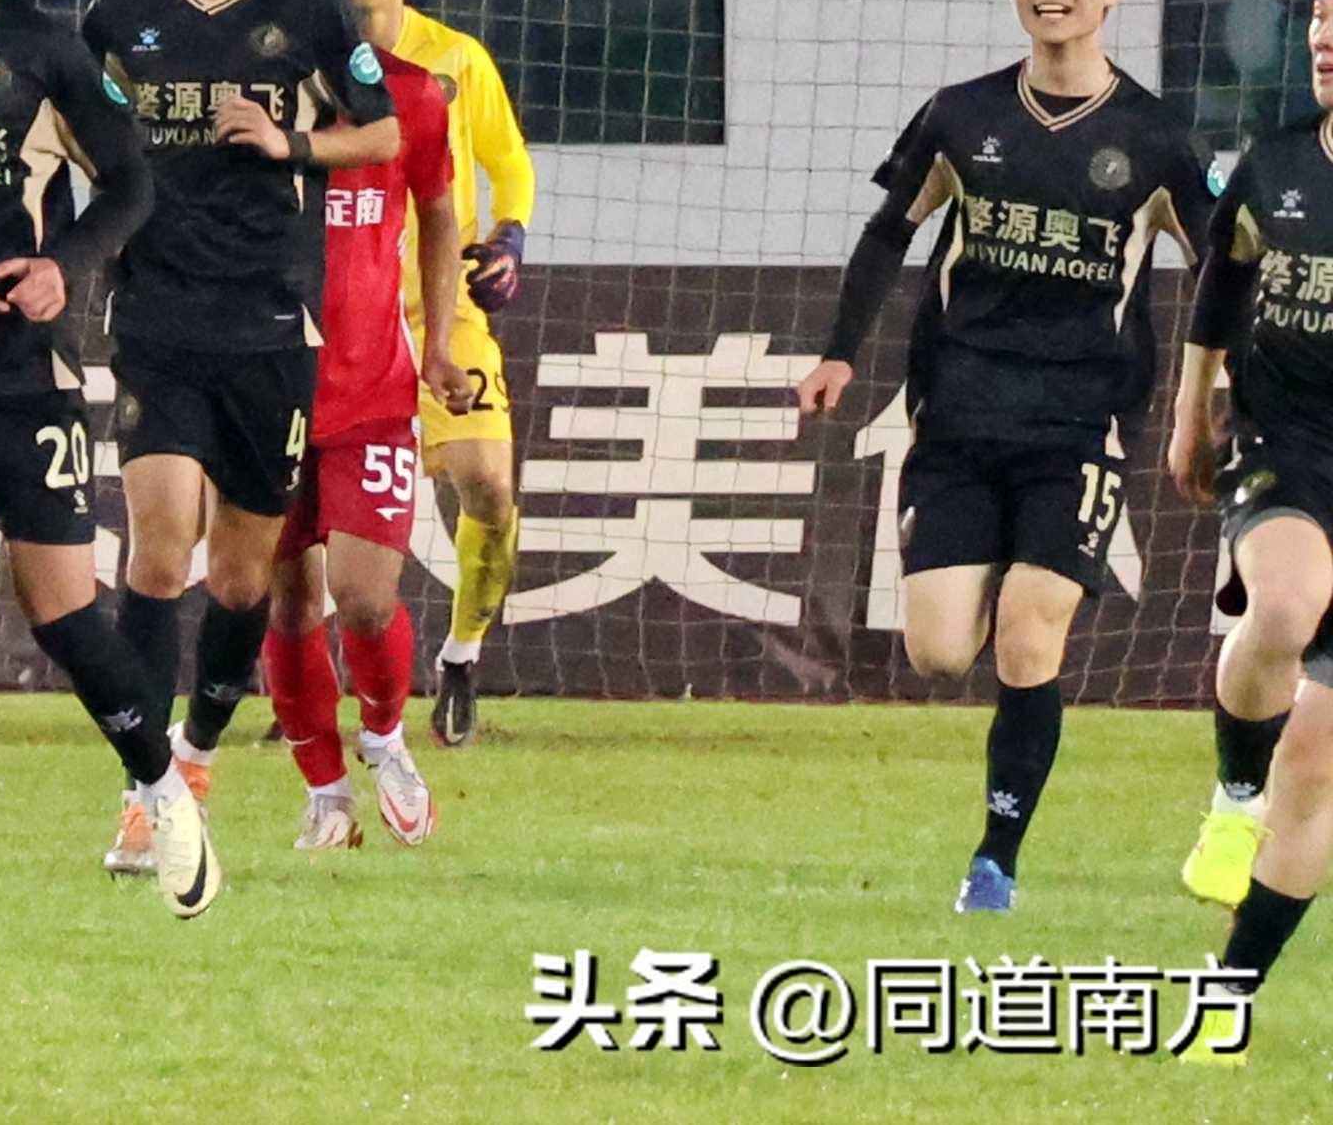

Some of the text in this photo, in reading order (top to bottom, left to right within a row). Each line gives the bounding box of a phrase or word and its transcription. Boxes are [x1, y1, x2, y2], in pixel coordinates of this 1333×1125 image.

[36, 421, 89, 489] 20
[285, 408, 306, 463] 4
[361, 443, 415, 502] 55
[1078, 462, 1122, 531] 15
